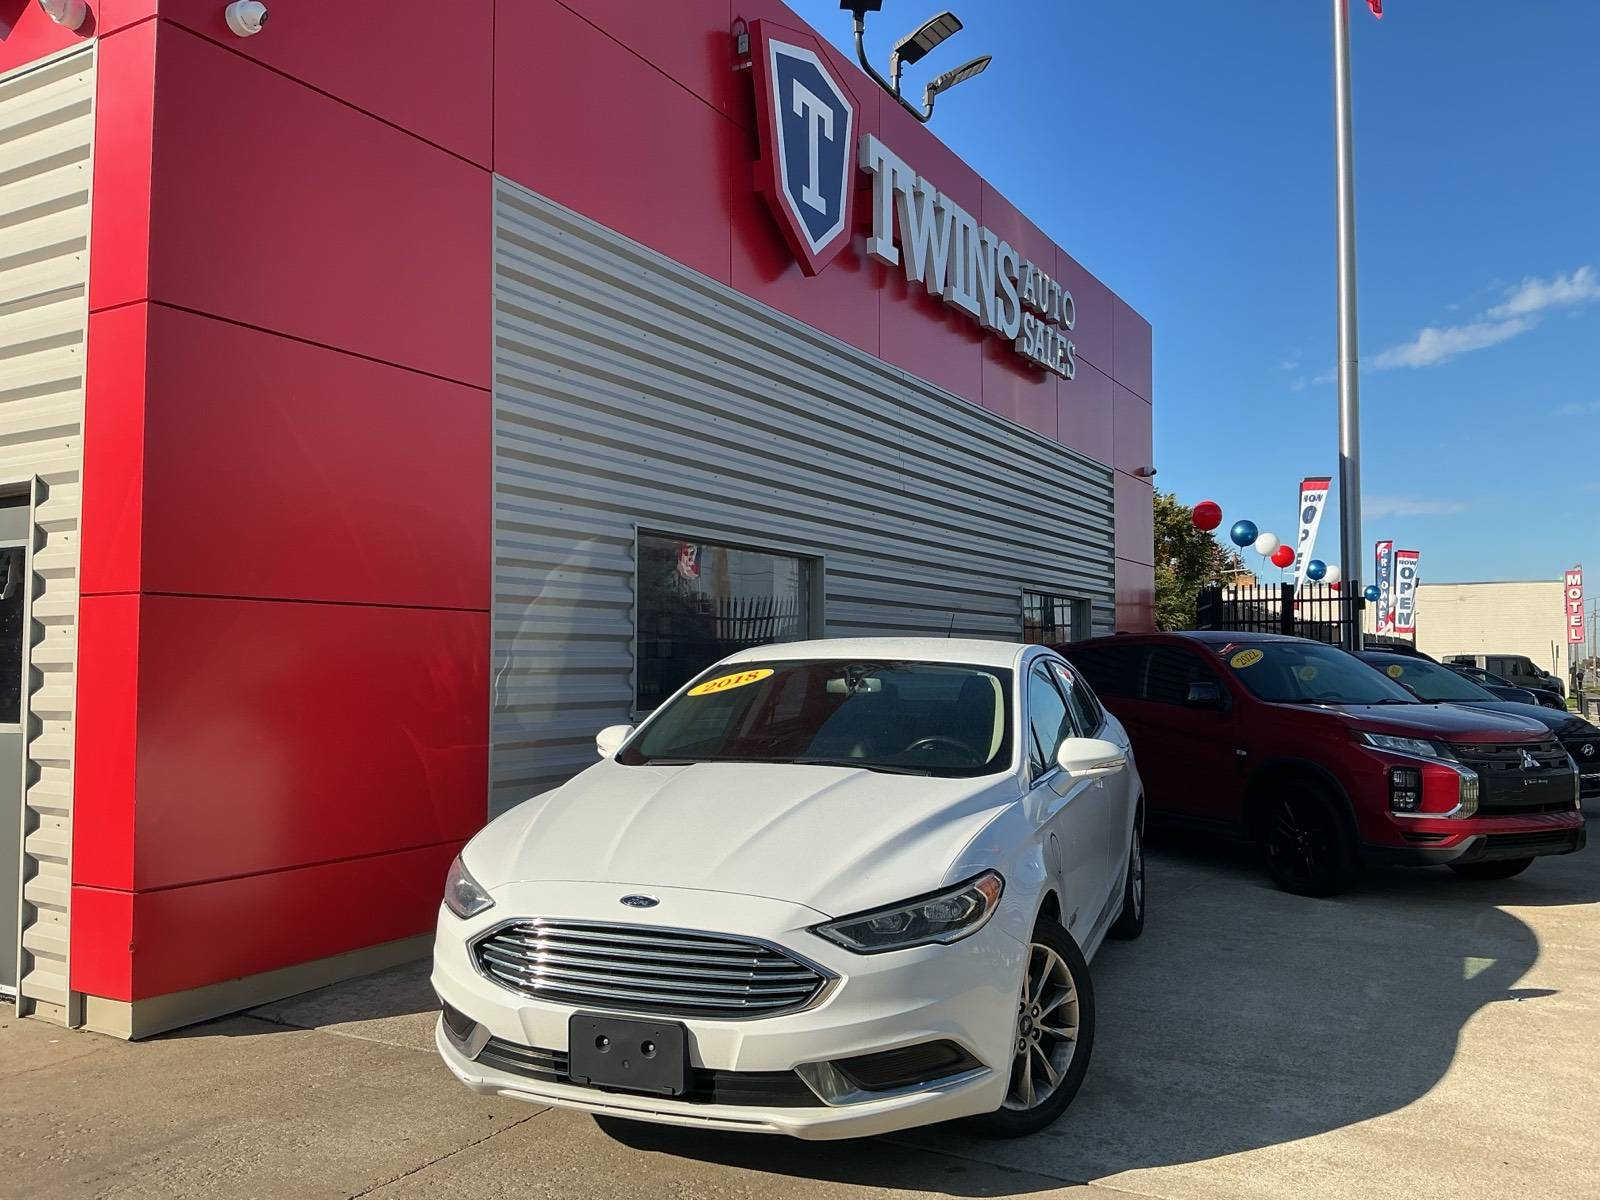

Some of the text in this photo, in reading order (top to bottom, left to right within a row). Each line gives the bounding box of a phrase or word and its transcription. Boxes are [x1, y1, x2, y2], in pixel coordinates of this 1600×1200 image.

[792, 78, 834, 215] T
[859, 133, 1021, 340] TWINS
[1021, 260, 1076, 331] AUTO
[1019, 312, 1076, 380] SALES
[1380, 548, 1389, 577] PRE
[1398, 567, 1414, 625] OPEN
[1567, 574, 1582, 641] MOTEL
[702, 671, 759, 693] 2018
